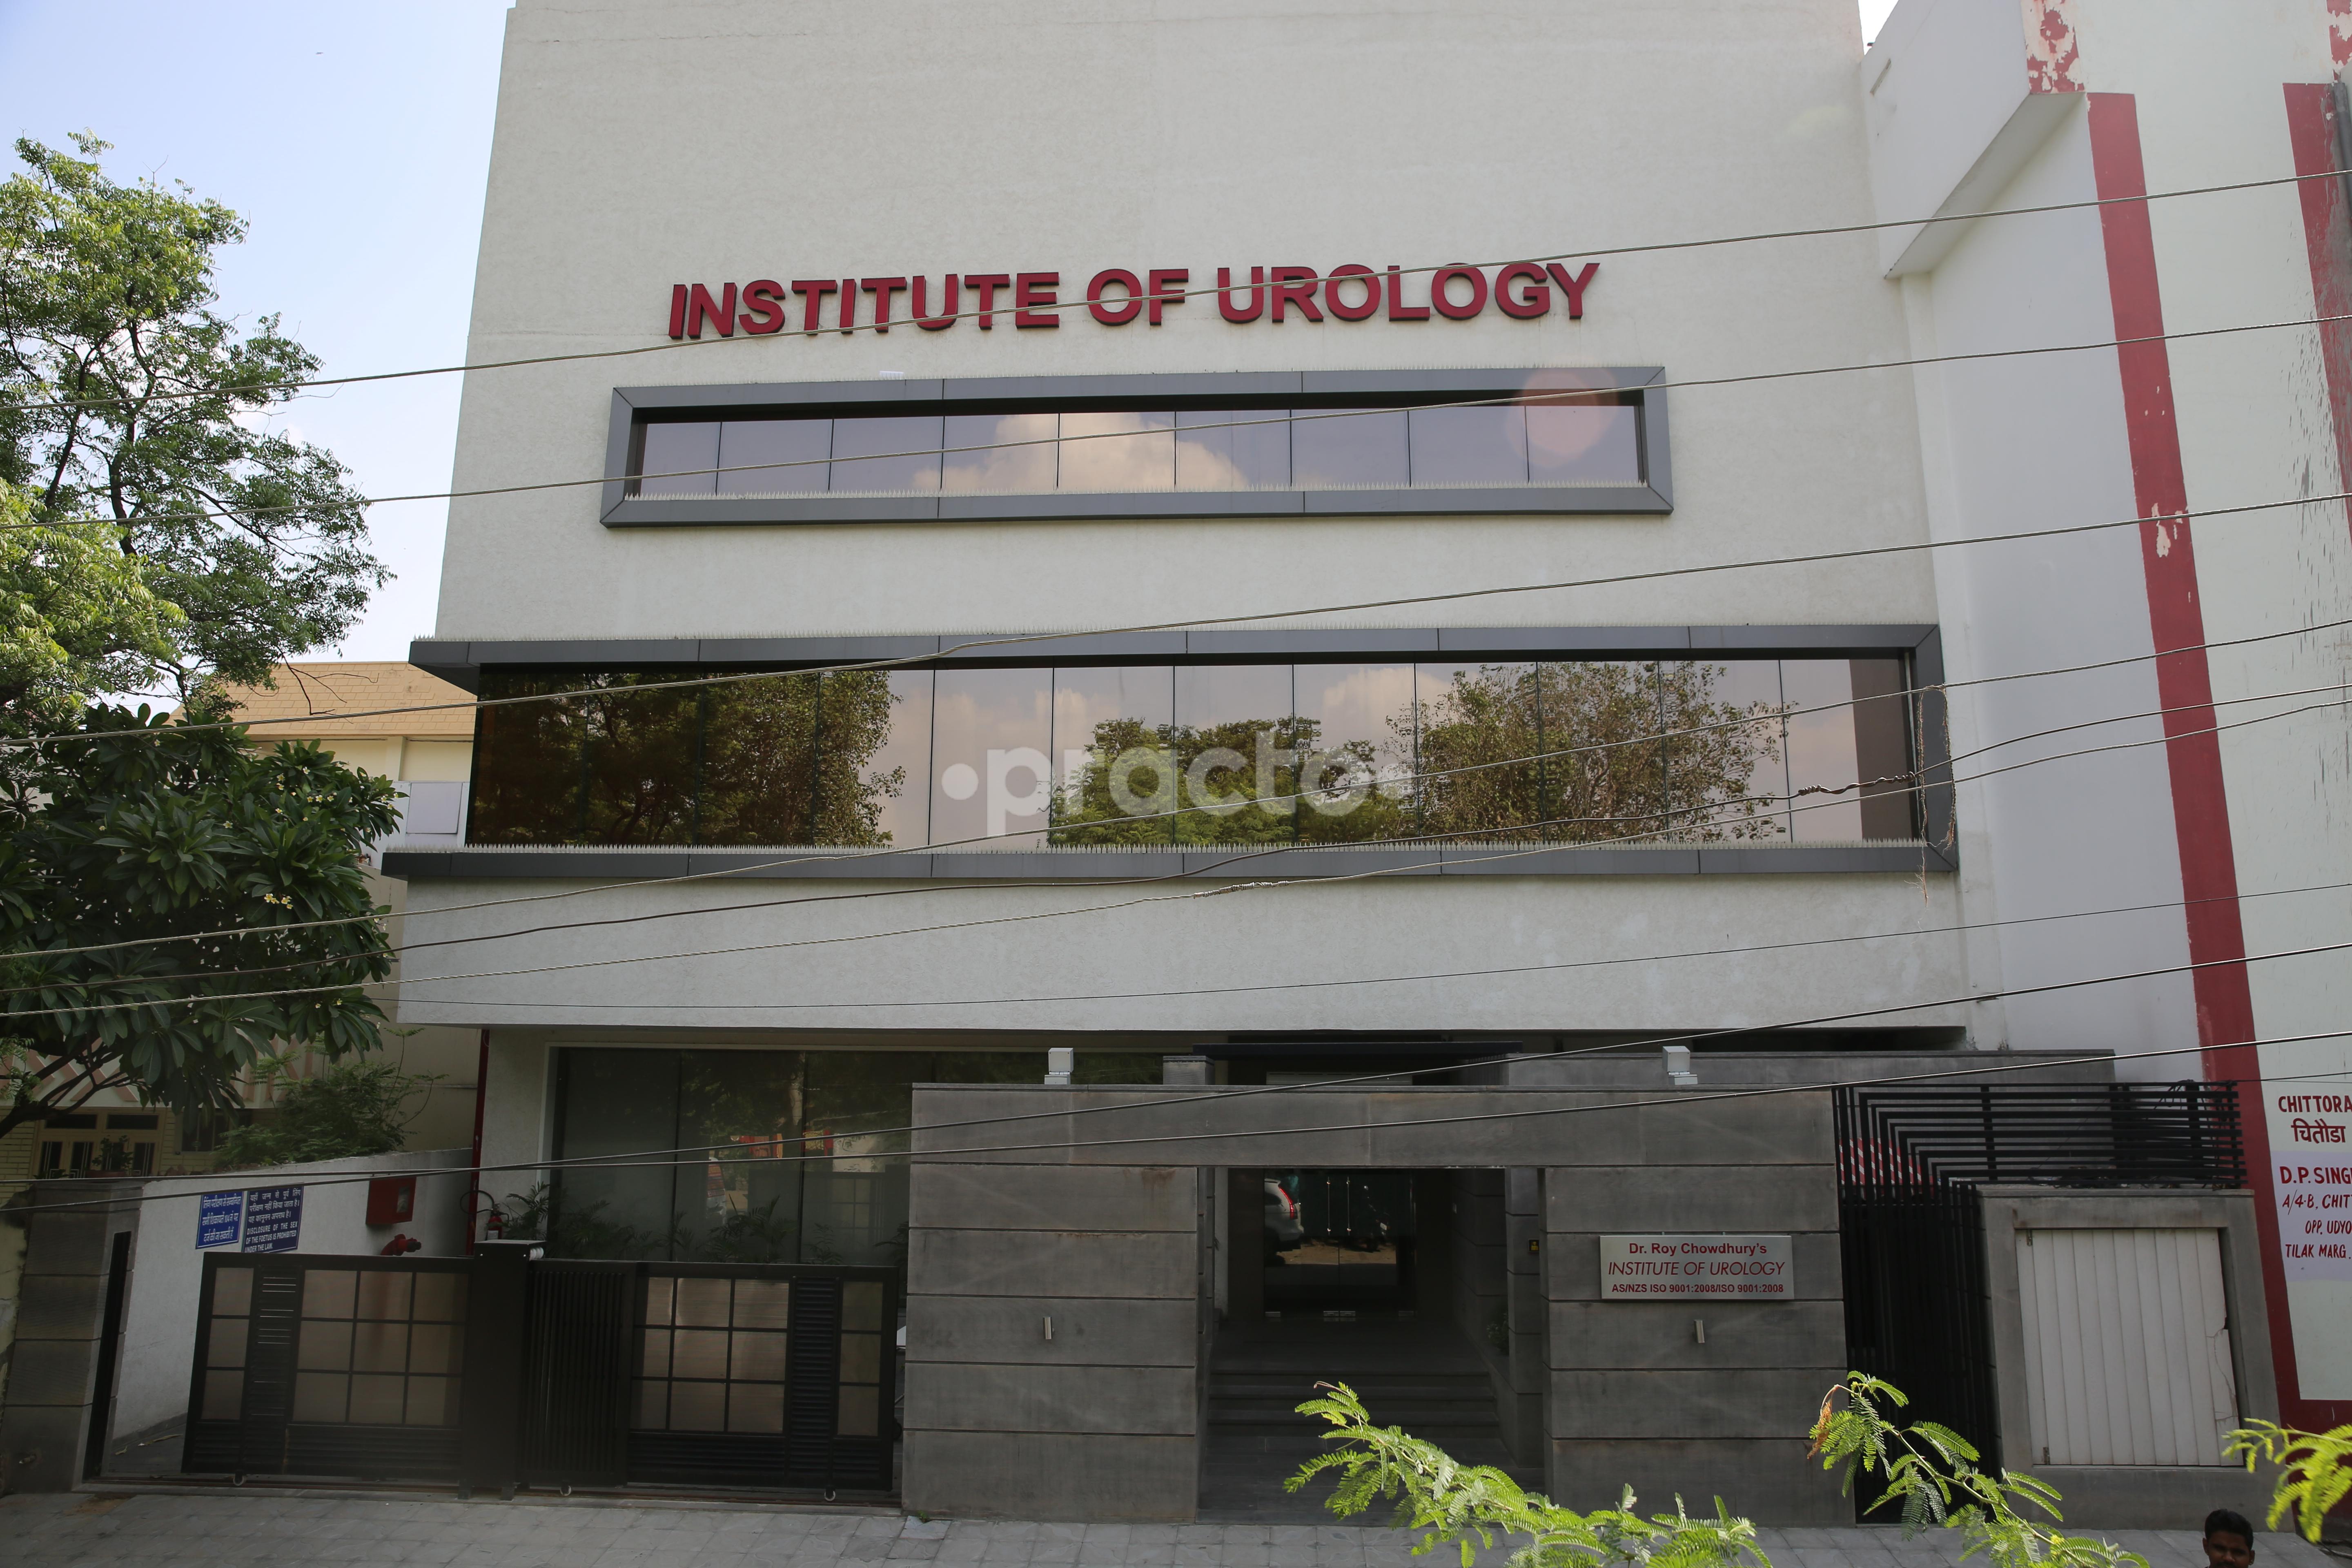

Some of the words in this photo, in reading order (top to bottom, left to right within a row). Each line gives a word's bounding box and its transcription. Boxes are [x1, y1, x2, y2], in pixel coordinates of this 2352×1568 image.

[668, 272, 1060, 339] INSTITUTE
[1086, 268, 1189, 326] OF
[1217, 263, 1600, 324] UROLOGY
[2278, 1095, 2352, 1113] CHITTORA
[275, 1190, 279, 1198] से
[2322, 1194, 2352, 1209] CHIT
[247, 1225, 271, 1235] DISCLOSURE
[2305, 1220, 2323, 1235] OPP.
[258, 1234, 273, 1243] FOETUS
[276, 1230, 297, 1240] PROHIBITED
[1629, 1243, 1647, 1254] Dr.
[1651, 1243, 1677, 1256] Roy
[2285, 1244, 2314, 1258] TILAK
[1608, 1262, 1679, 1275] INSTITUTE
[1684, 1262, 1706, 1275] OF
[1710, 1262, 1786, 1275] UROLOGY
[1612, 1284, 1647, 1293] AS/NZS
[1650, 1284, 1667, 1293] ISO
[1669, 1284, 1735, 1293] 9001:2008/ISO
[1737, 1284, 1784, 1293] 9001:2008
